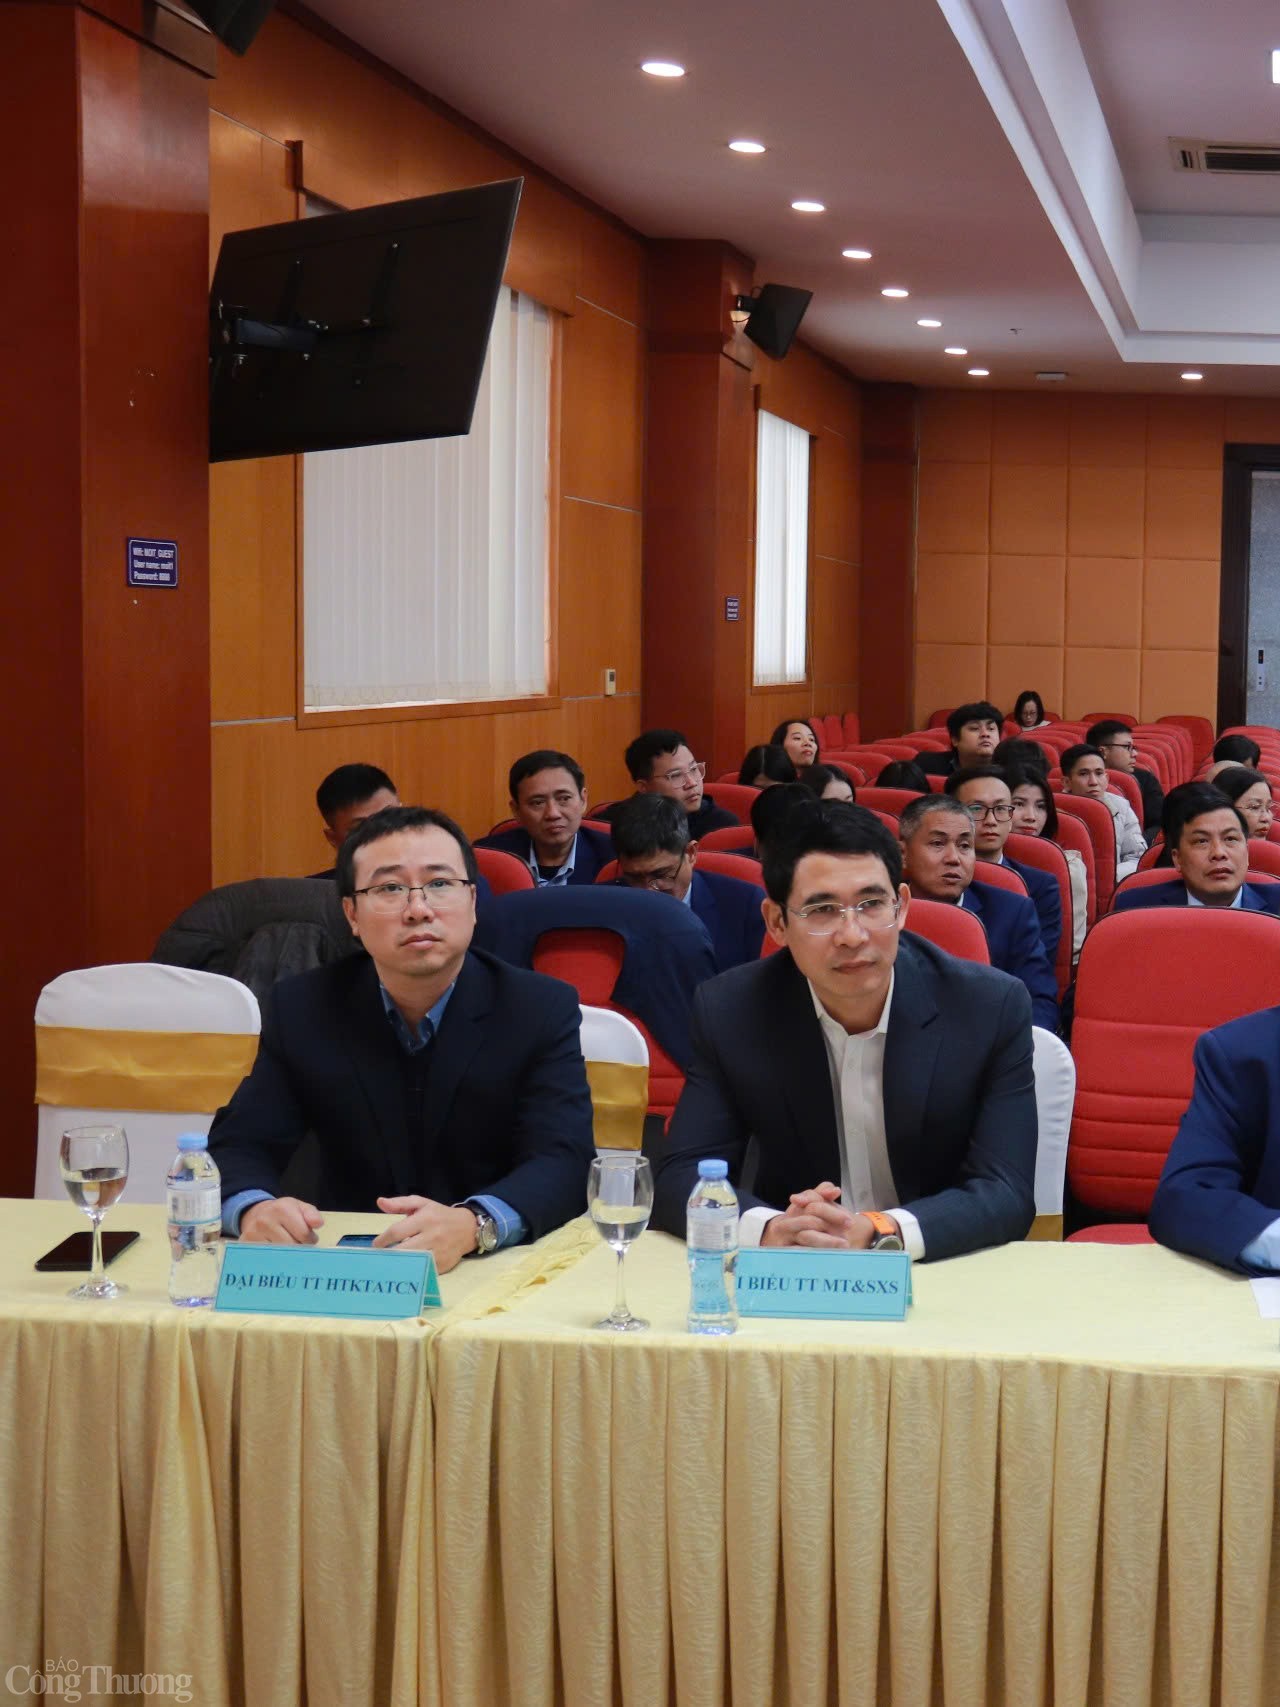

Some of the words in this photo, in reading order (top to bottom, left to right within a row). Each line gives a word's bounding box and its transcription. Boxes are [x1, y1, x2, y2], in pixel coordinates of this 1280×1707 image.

[225, 1272, 254, 1291] ĐẠI
[301, 1276, 325, 1290] TT
[325, 1277, 420, 1295] HTKTATCN
[795, 1278, 819, 1292] TT
[822, 1279, 899, 1294] MT&SXS
